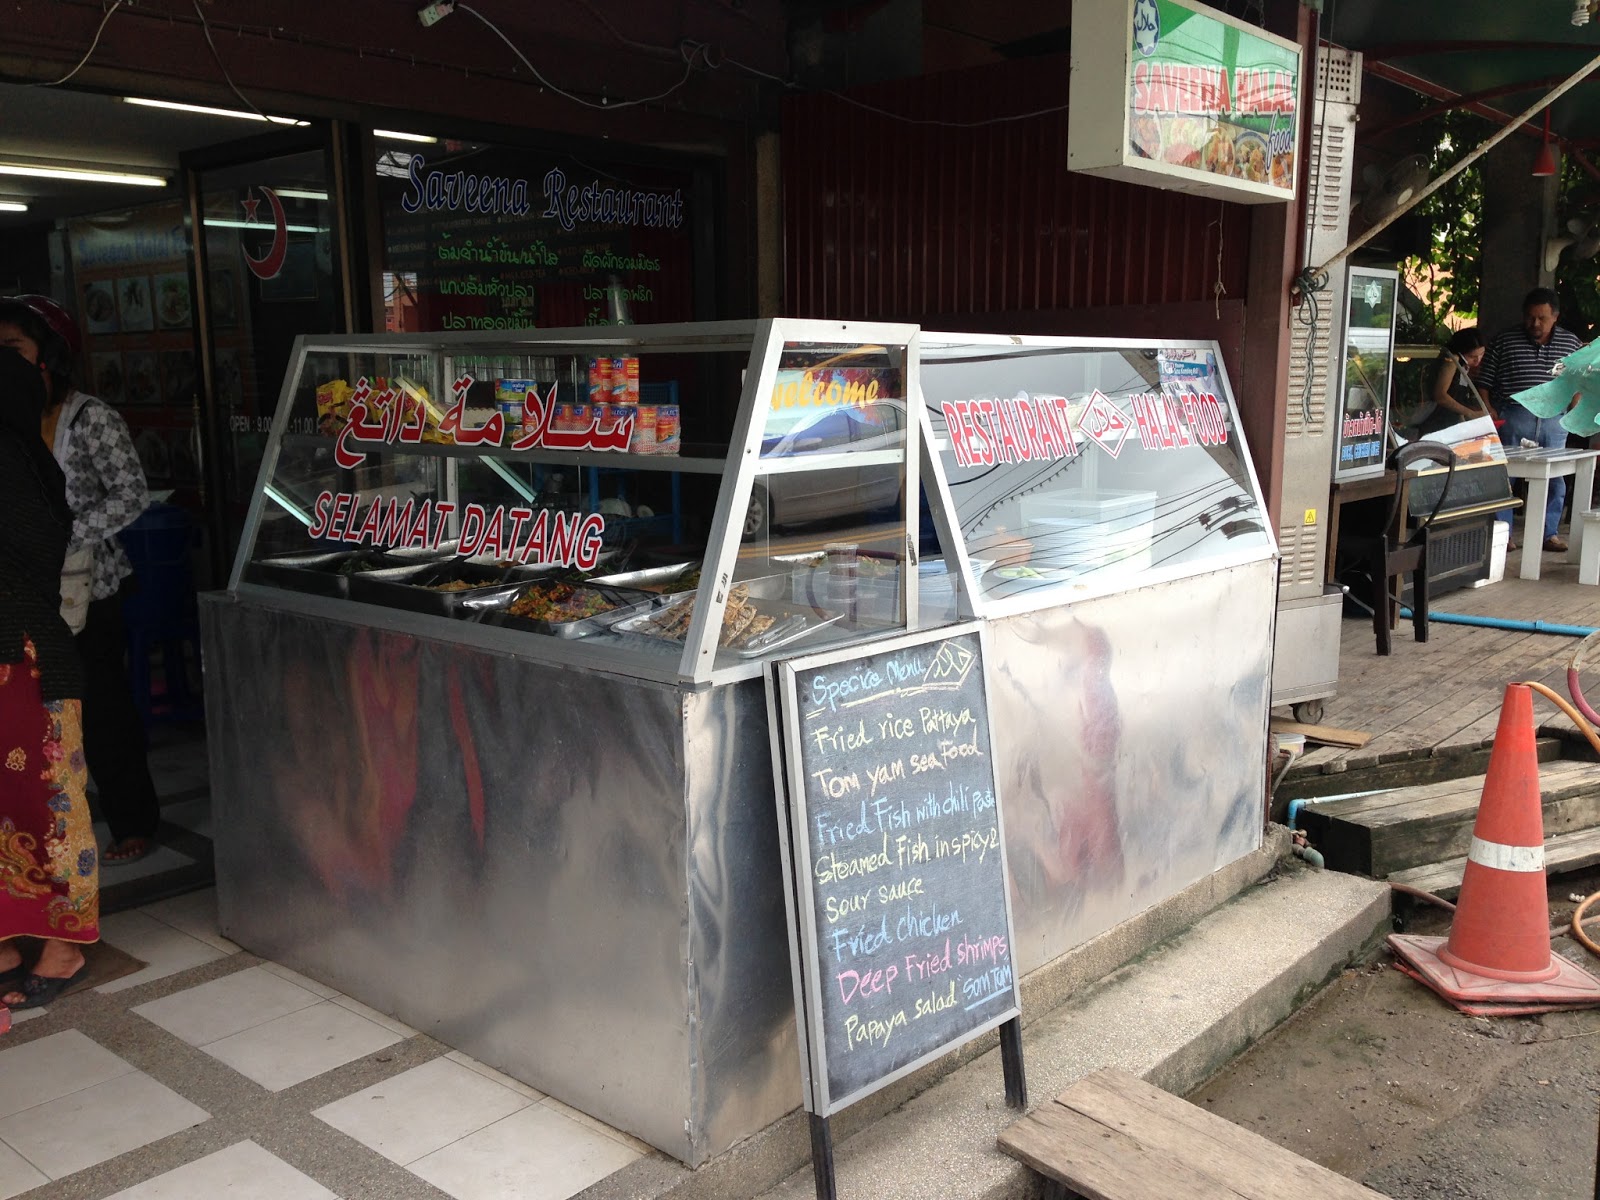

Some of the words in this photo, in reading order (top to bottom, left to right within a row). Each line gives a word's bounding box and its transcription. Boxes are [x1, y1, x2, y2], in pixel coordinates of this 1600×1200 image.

[1134, 60, 1232, 116] SAVEENA
[1235, 66, 1296, 116] HALAL
[1265, 113, 1295, 174] food
[401, 154, 530, 217] Saveena
[542, 166, 683, 231] Restaurant
[582, 282, 653, 302] ปลาดพริก
[229, 415, 250, 432] OPEN
[438, 373, 636, 453] سلامة
[940, 397, 1079, 468] RESTAURANT
[1129, 392, 1190, 451] HALAL
[1179, 391, 1229, 447] FOOD
[308, 490, 456, 553] SELAMAT
[455, 502, 606, 572] DATANG
[810, 719, 874, 754] Fried
[878, 713, 915, 739] rice
[918, 706, 977, 737] Pattaya
[811, 768, 862, 799] Tom
[866, 759, 907, 797] yam
[814, 800, 876, 852] Fried
[868, 796, 912, 832] Fish
[916, 792, 941, 823] with
[814, 831, 895, 885] Steamed
[895, 833, 932, 870] Fish
[878, 877, 925, 904] sauce
[830, 914, 894, 962] Fried
[836, 964, 899, 1006] Deep
[904, 937, 953, 982] Fried
[844, 1009, 908, 1052] Papaya
[912, 978, 959, 1020] salad
